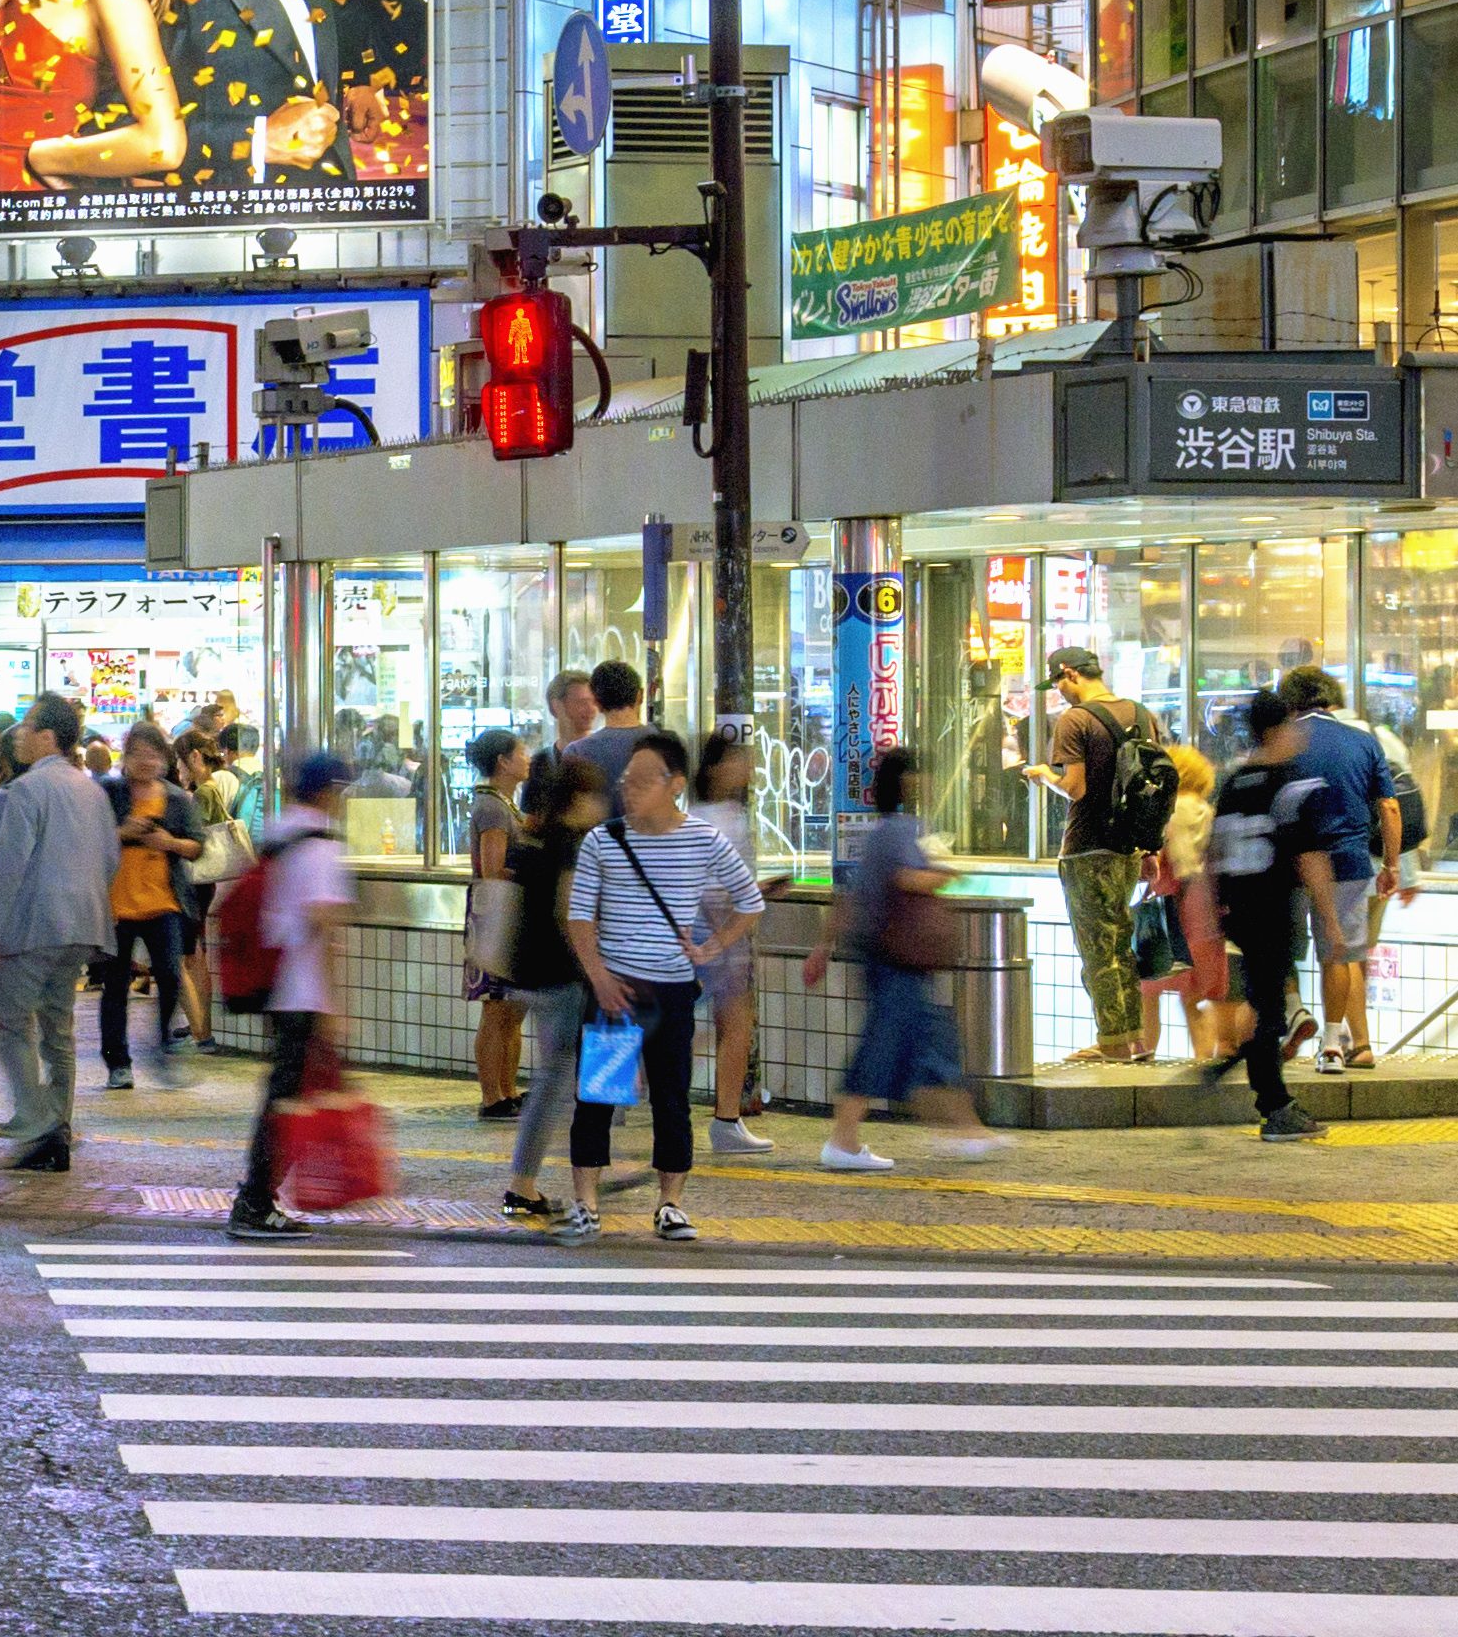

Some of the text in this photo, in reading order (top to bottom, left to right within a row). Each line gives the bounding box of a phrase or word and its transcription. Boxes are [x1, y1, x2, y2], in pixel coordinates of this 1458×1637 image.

[80, 192, 178, 206] 金融商品取引業者
[836, 282, 898, 327] Swallows
[1211, 396, 1281, 414] 東急電鉄
[1307, 428, 1378, 443] Shibuya Sta.
[1175, 426, 1297, 470] 渋谷駅
[1307, 459, 1347, 470] 시부야역
[877, 587, 895, 611] 6
